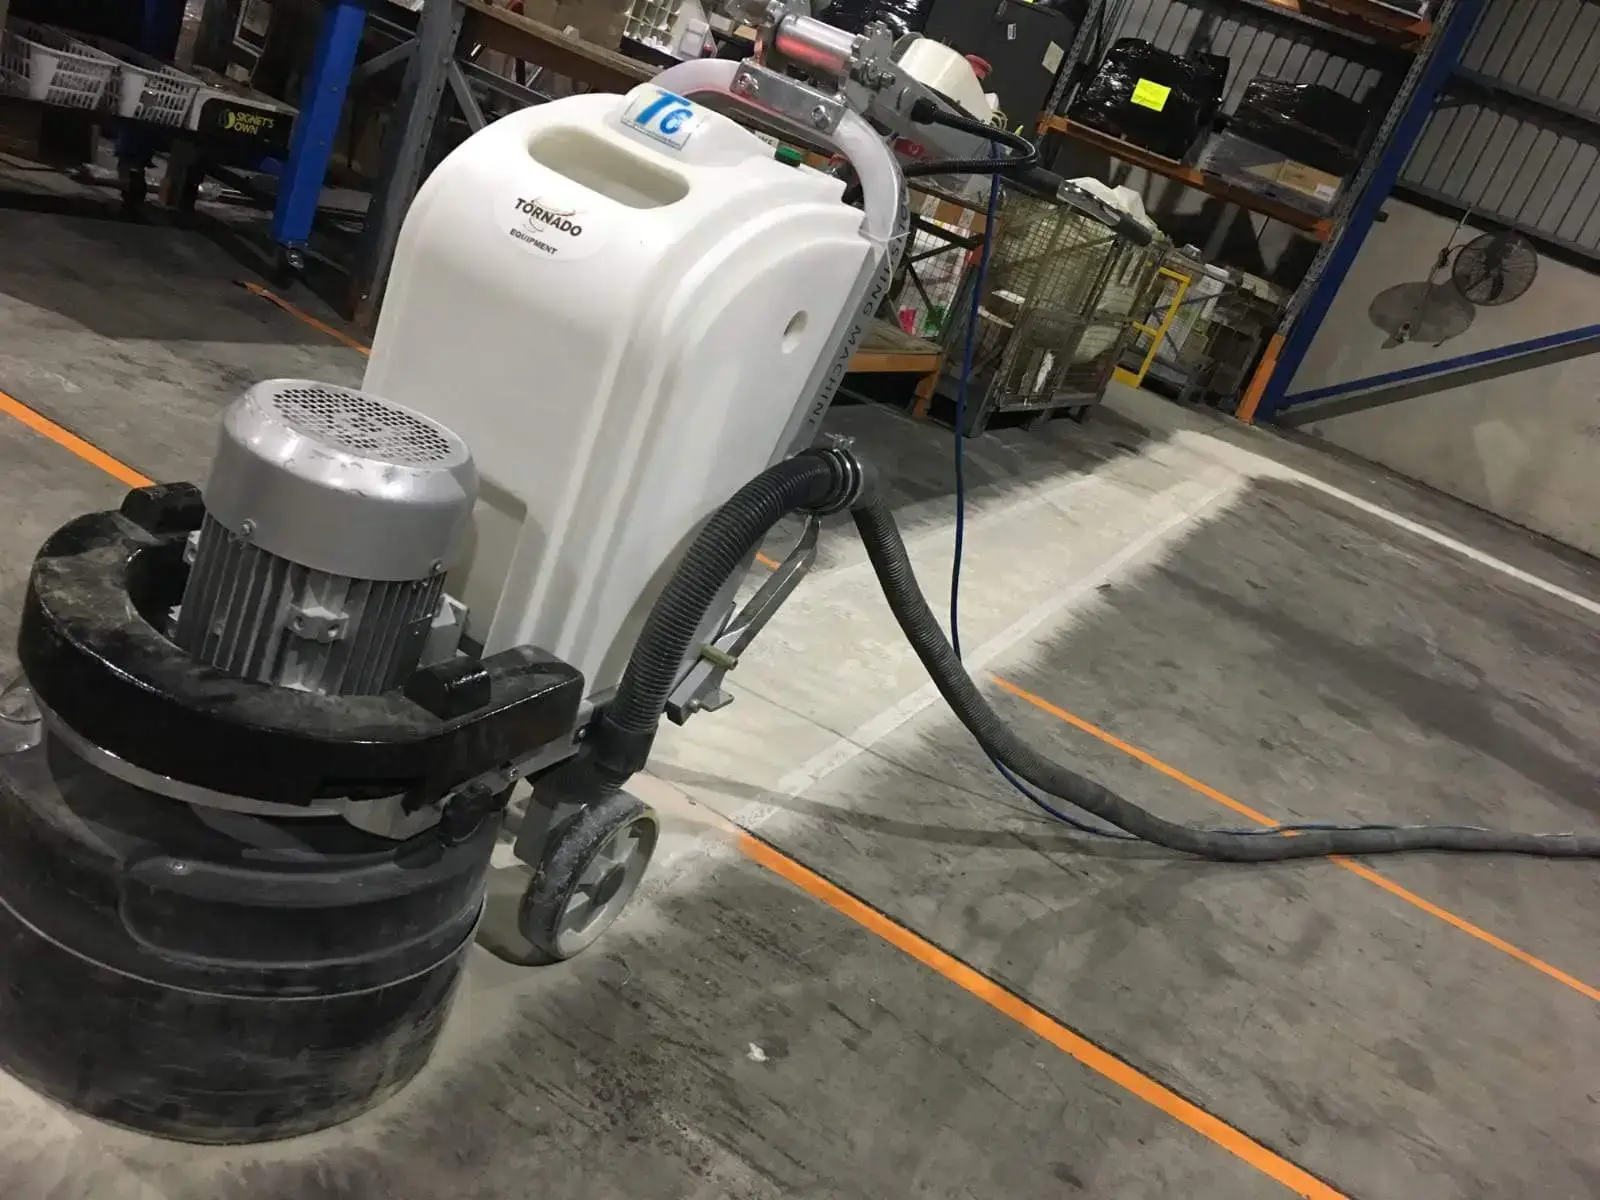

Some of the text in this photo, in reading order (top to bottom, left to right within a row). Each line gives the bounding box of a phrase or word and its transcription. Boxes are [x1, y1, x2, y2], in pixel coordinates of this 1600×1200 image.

[234, 121, 258, 135] OWN
[514, 198, 583, 237] TORNADO
[509, 227, 558, 255] EQUIPMENT
